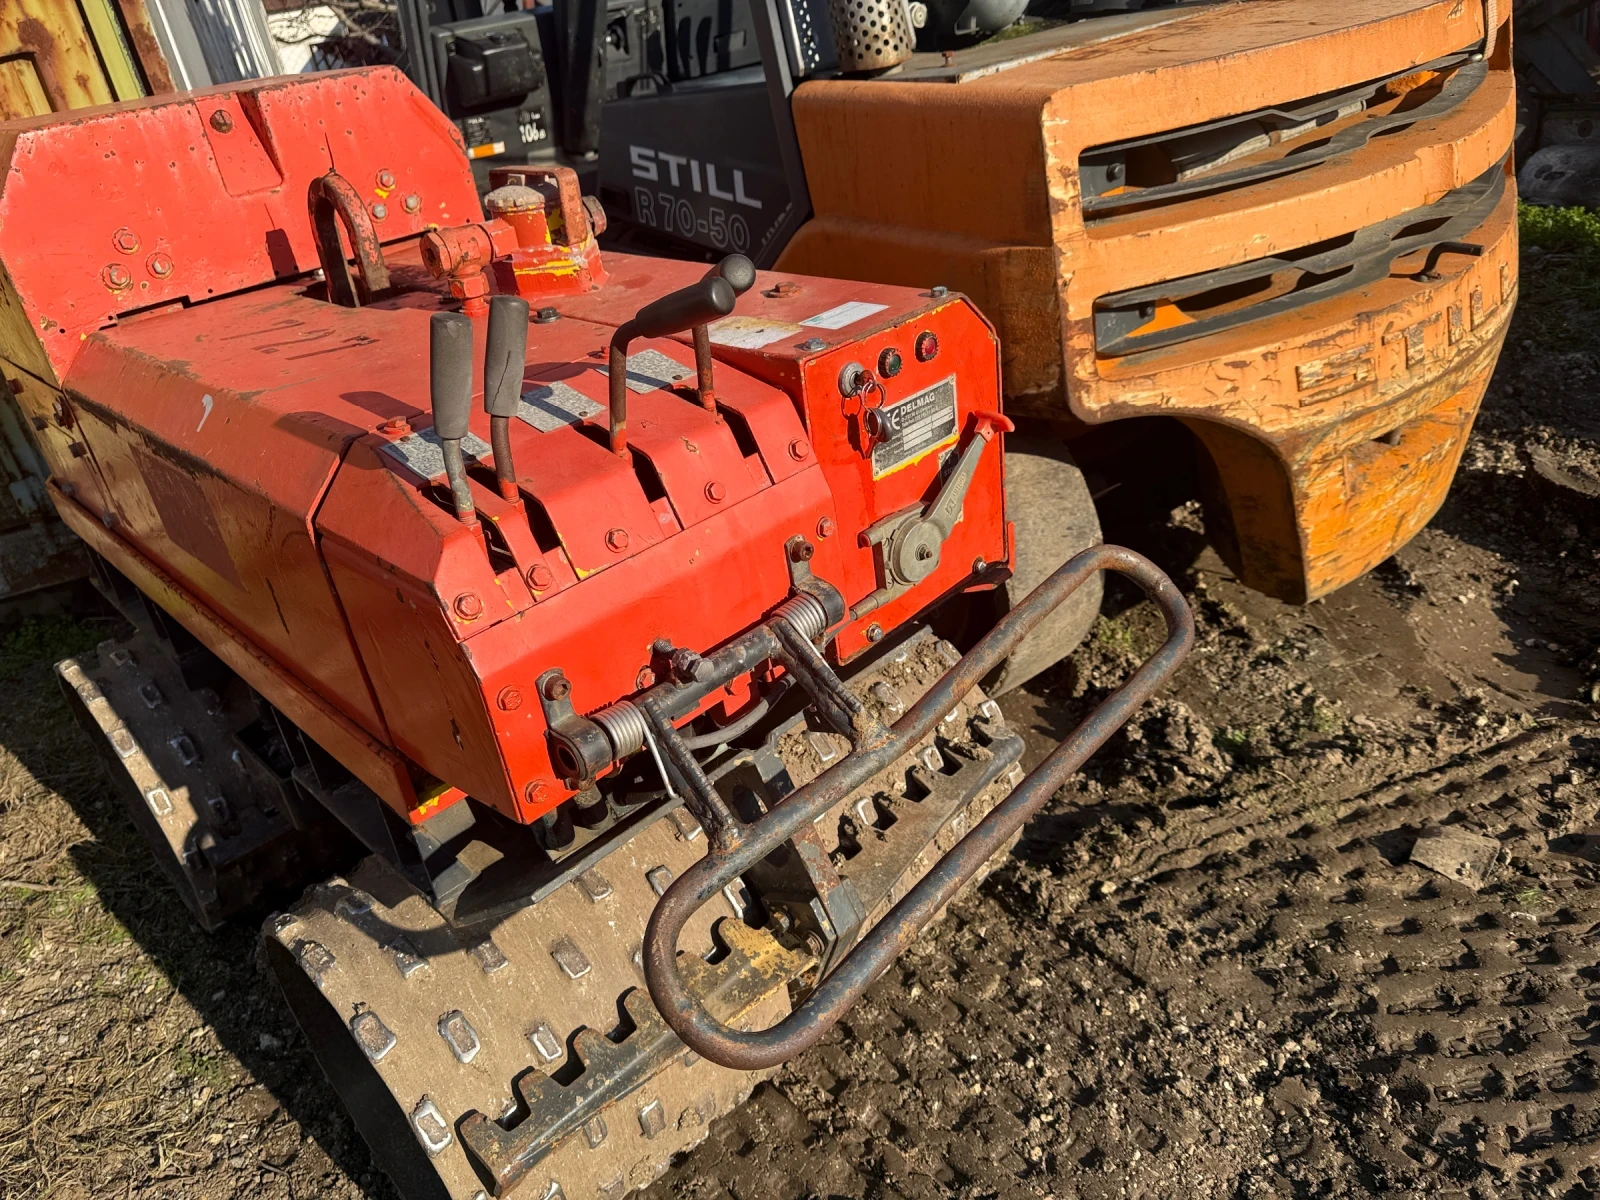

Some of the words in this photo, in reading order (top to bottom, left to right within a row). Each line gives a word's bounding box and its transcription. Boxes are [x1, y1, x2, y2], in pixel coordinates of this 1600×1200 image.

[629, 145, 763, 210] STILL
[634, 186, 657, 227] R
[658, 192, 751, 254] 70-50
[900, 392, 936, 416] DELMAG
